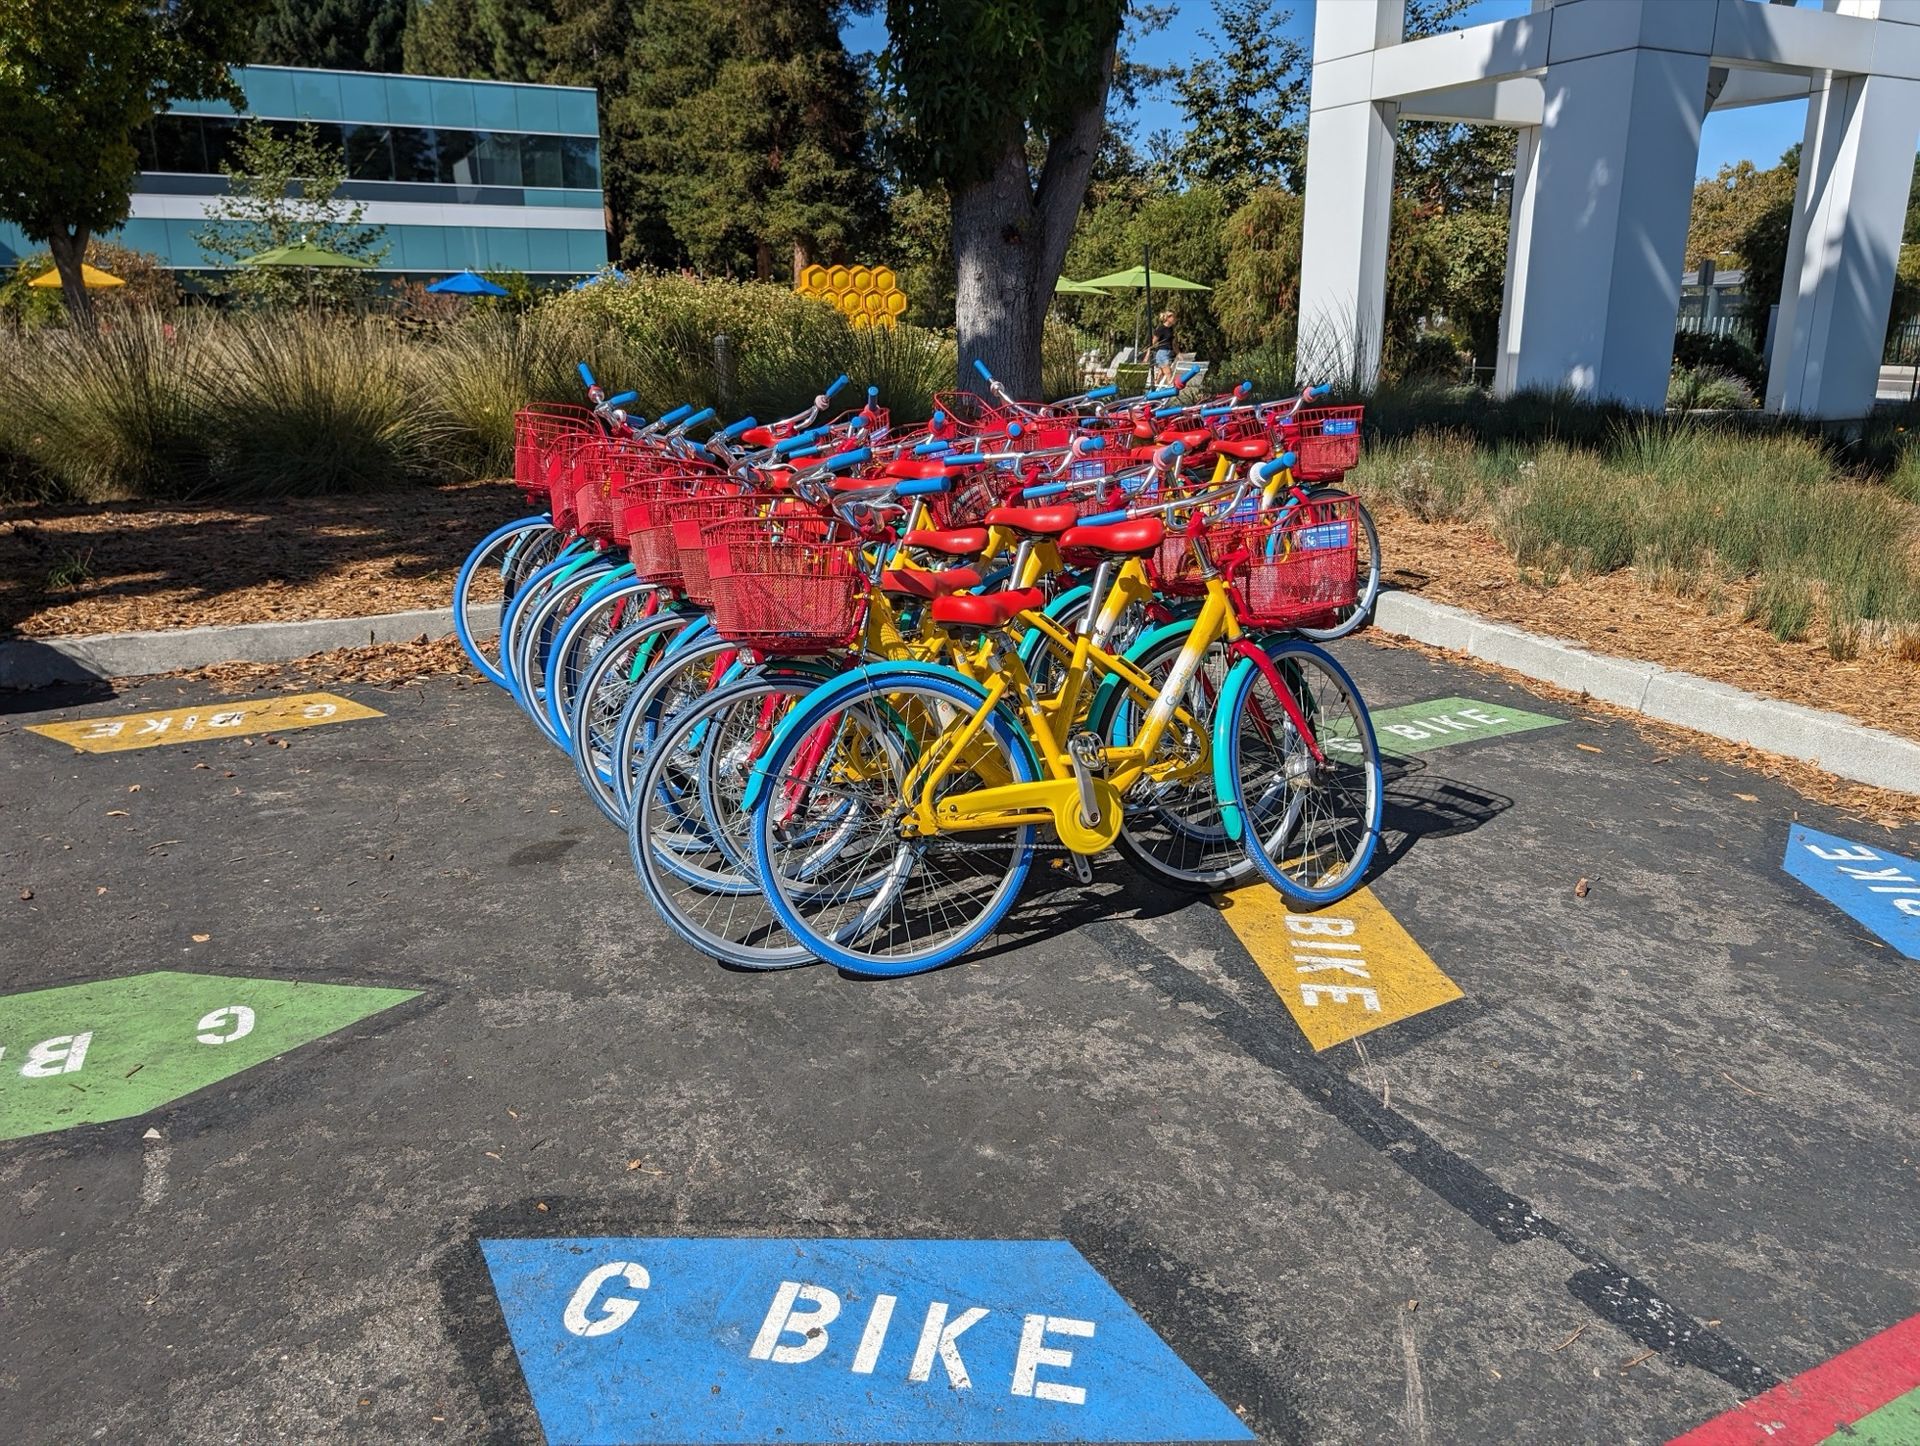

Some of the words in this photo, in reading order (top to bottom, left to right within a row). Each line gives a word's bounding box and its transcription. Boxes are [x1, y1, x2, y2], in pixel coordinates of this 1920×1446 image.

[81, 711, 246, 740] BIKE
[303, 703, 338, 720] G
[1381, 708, 1509, 740] BIKE
[1284, 915, 1382, 1012] BIKE
[197, 1005, 256, 1045] G
[562, 1261, 651, 1338] G
[748, 1280, 1097, 1406] BIKE
